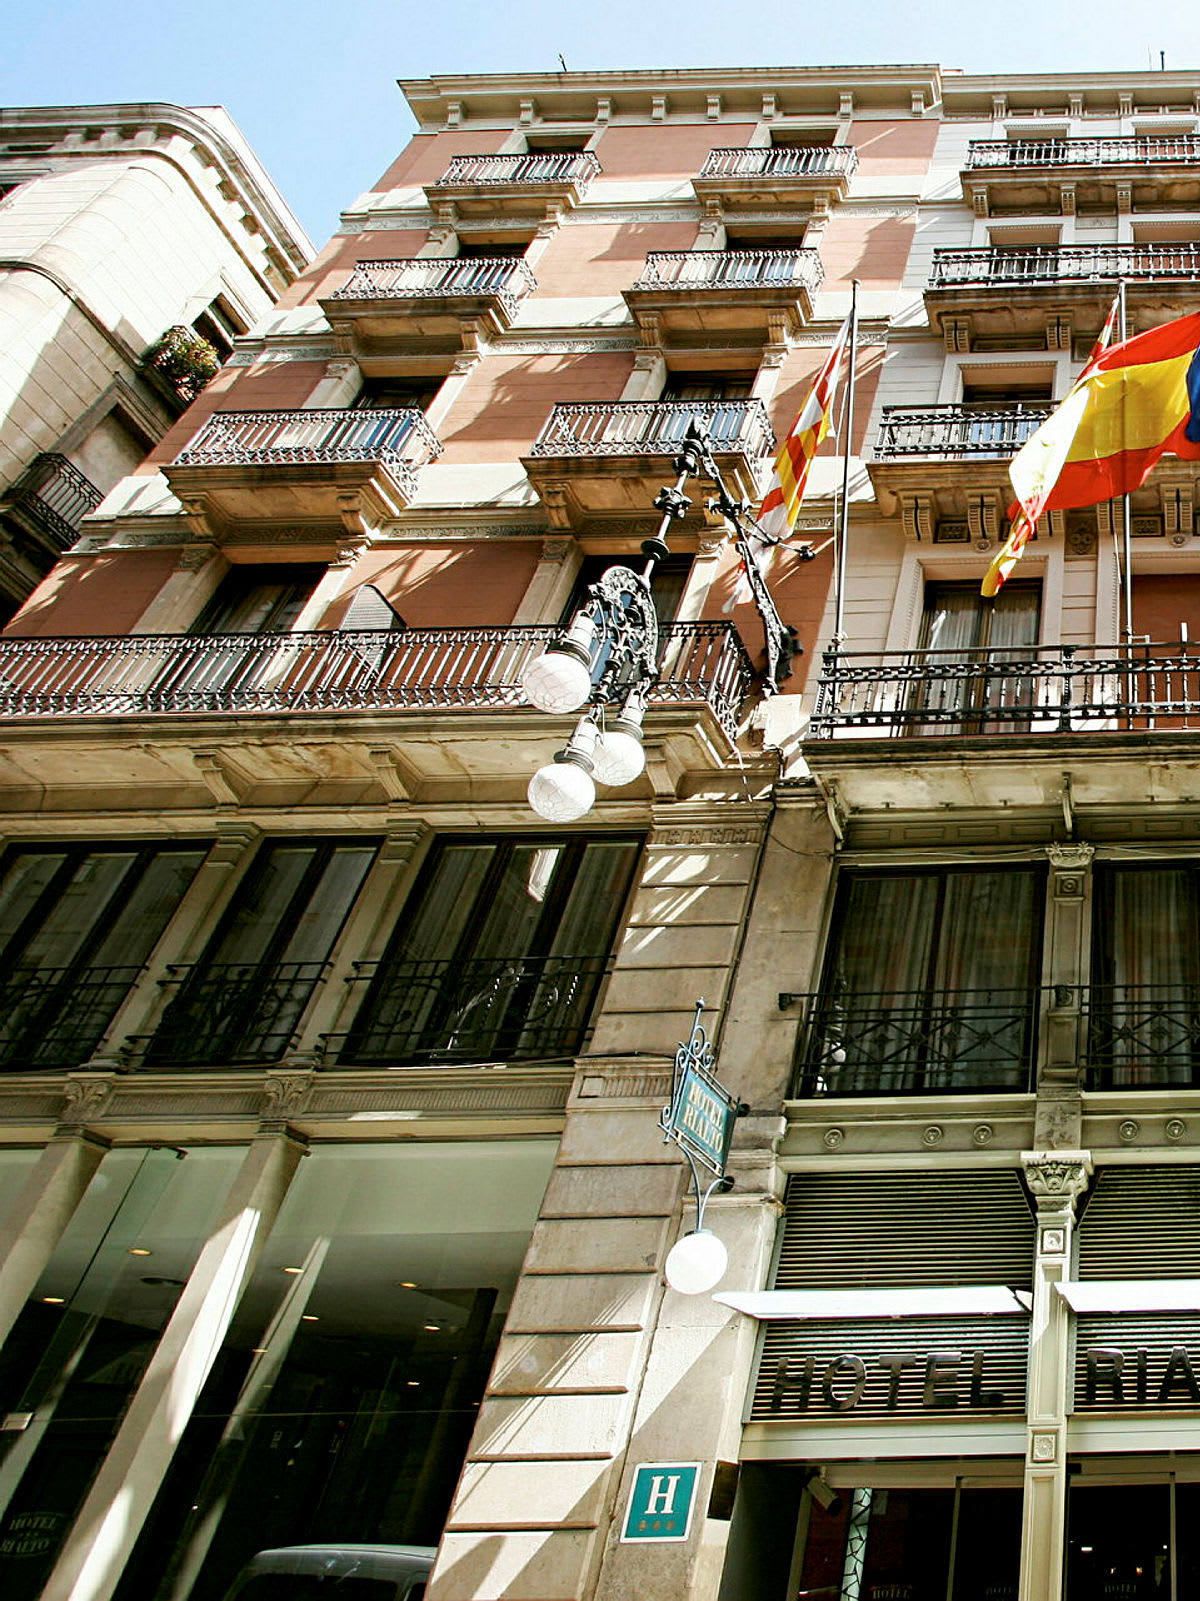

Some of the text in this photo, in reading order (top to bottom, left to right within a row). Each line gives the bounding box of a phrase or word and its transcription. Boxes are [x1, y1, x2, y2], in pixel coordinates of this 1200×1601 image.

[682, 1105, 725, 1155] RIALTO
[687, 1081, 725, 1131] HOTEL
[770, 1350, 1004, 1410] HOTEL
[644, 1475, 681, 1514] H
